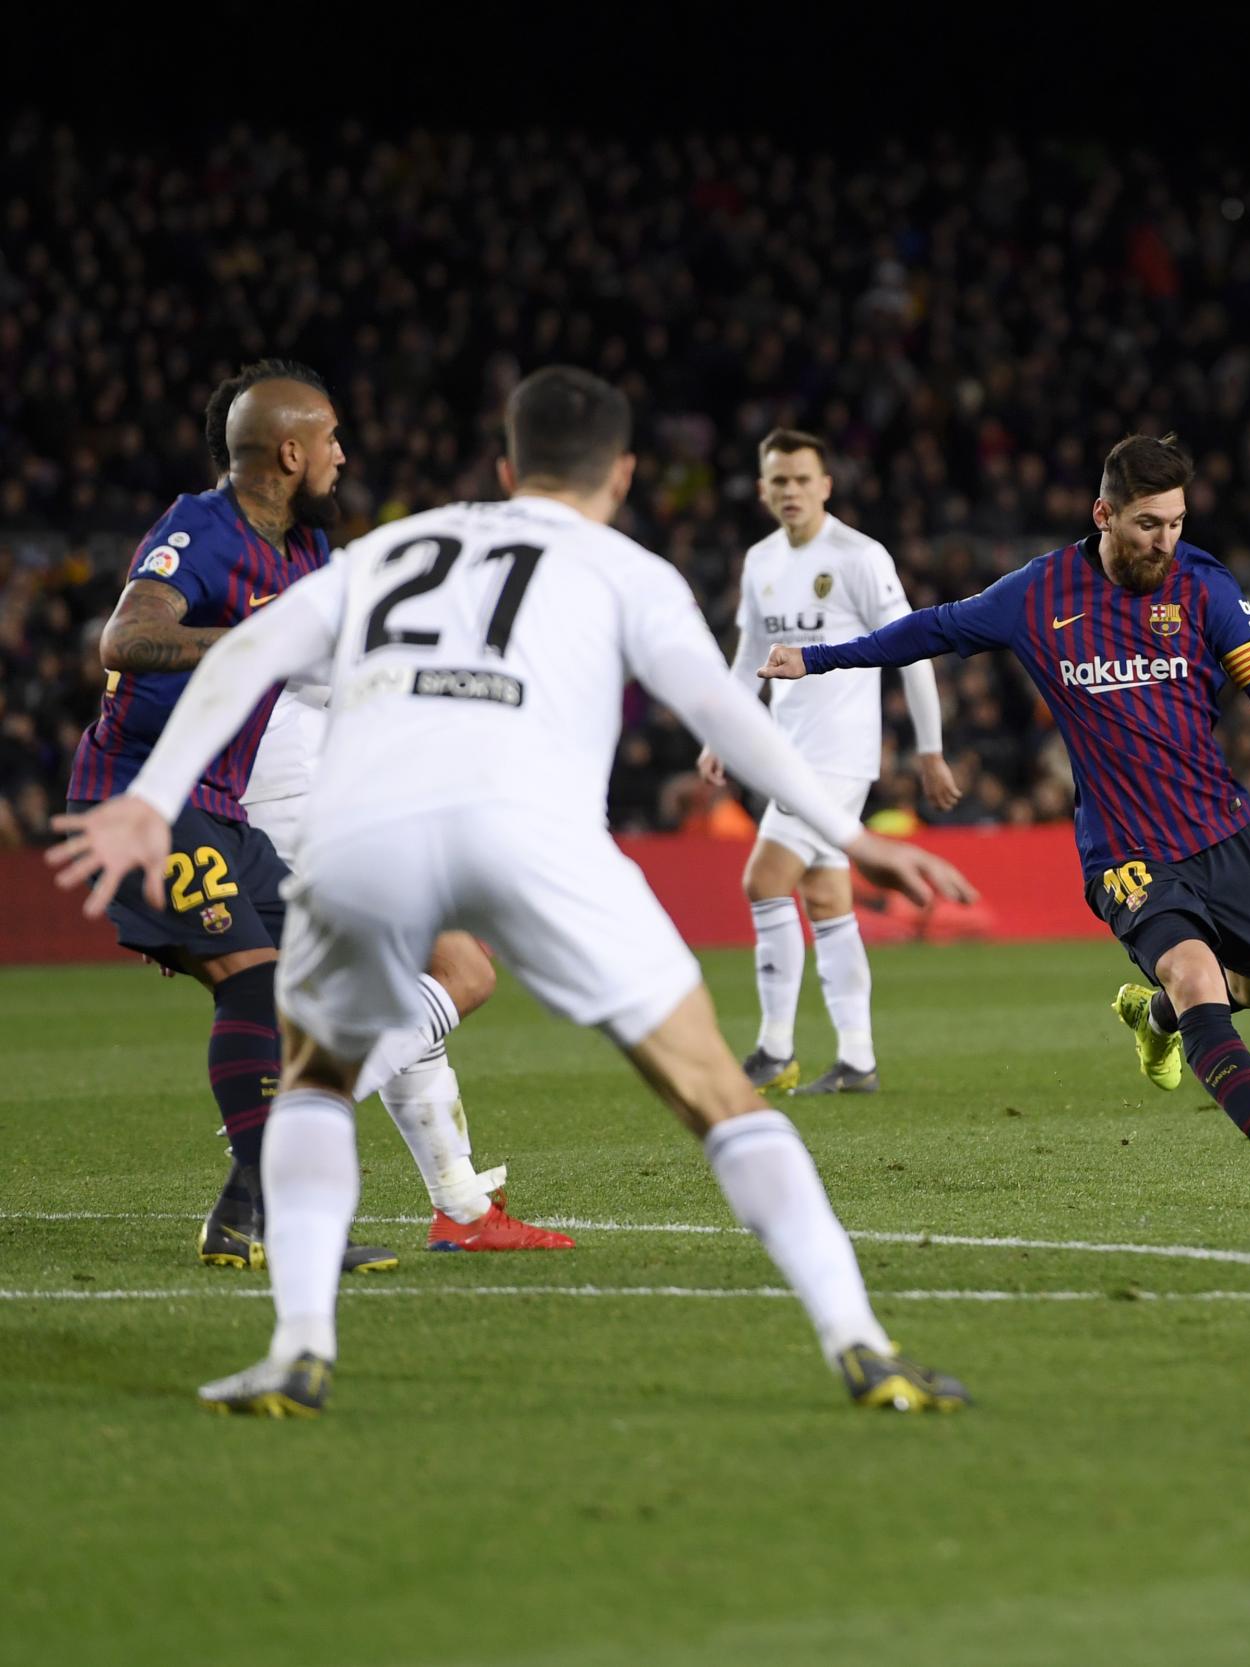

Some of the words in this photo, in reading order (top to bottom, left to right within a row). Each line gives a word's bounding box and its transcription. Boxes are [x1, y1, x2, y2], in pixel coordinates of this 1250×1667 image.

[362, 535, 546, 658] 21
[764, 612, 825, 634] BLU
[1060, 654, 1188, 687] Rakuten
[163, 846, 239, 912] 22
